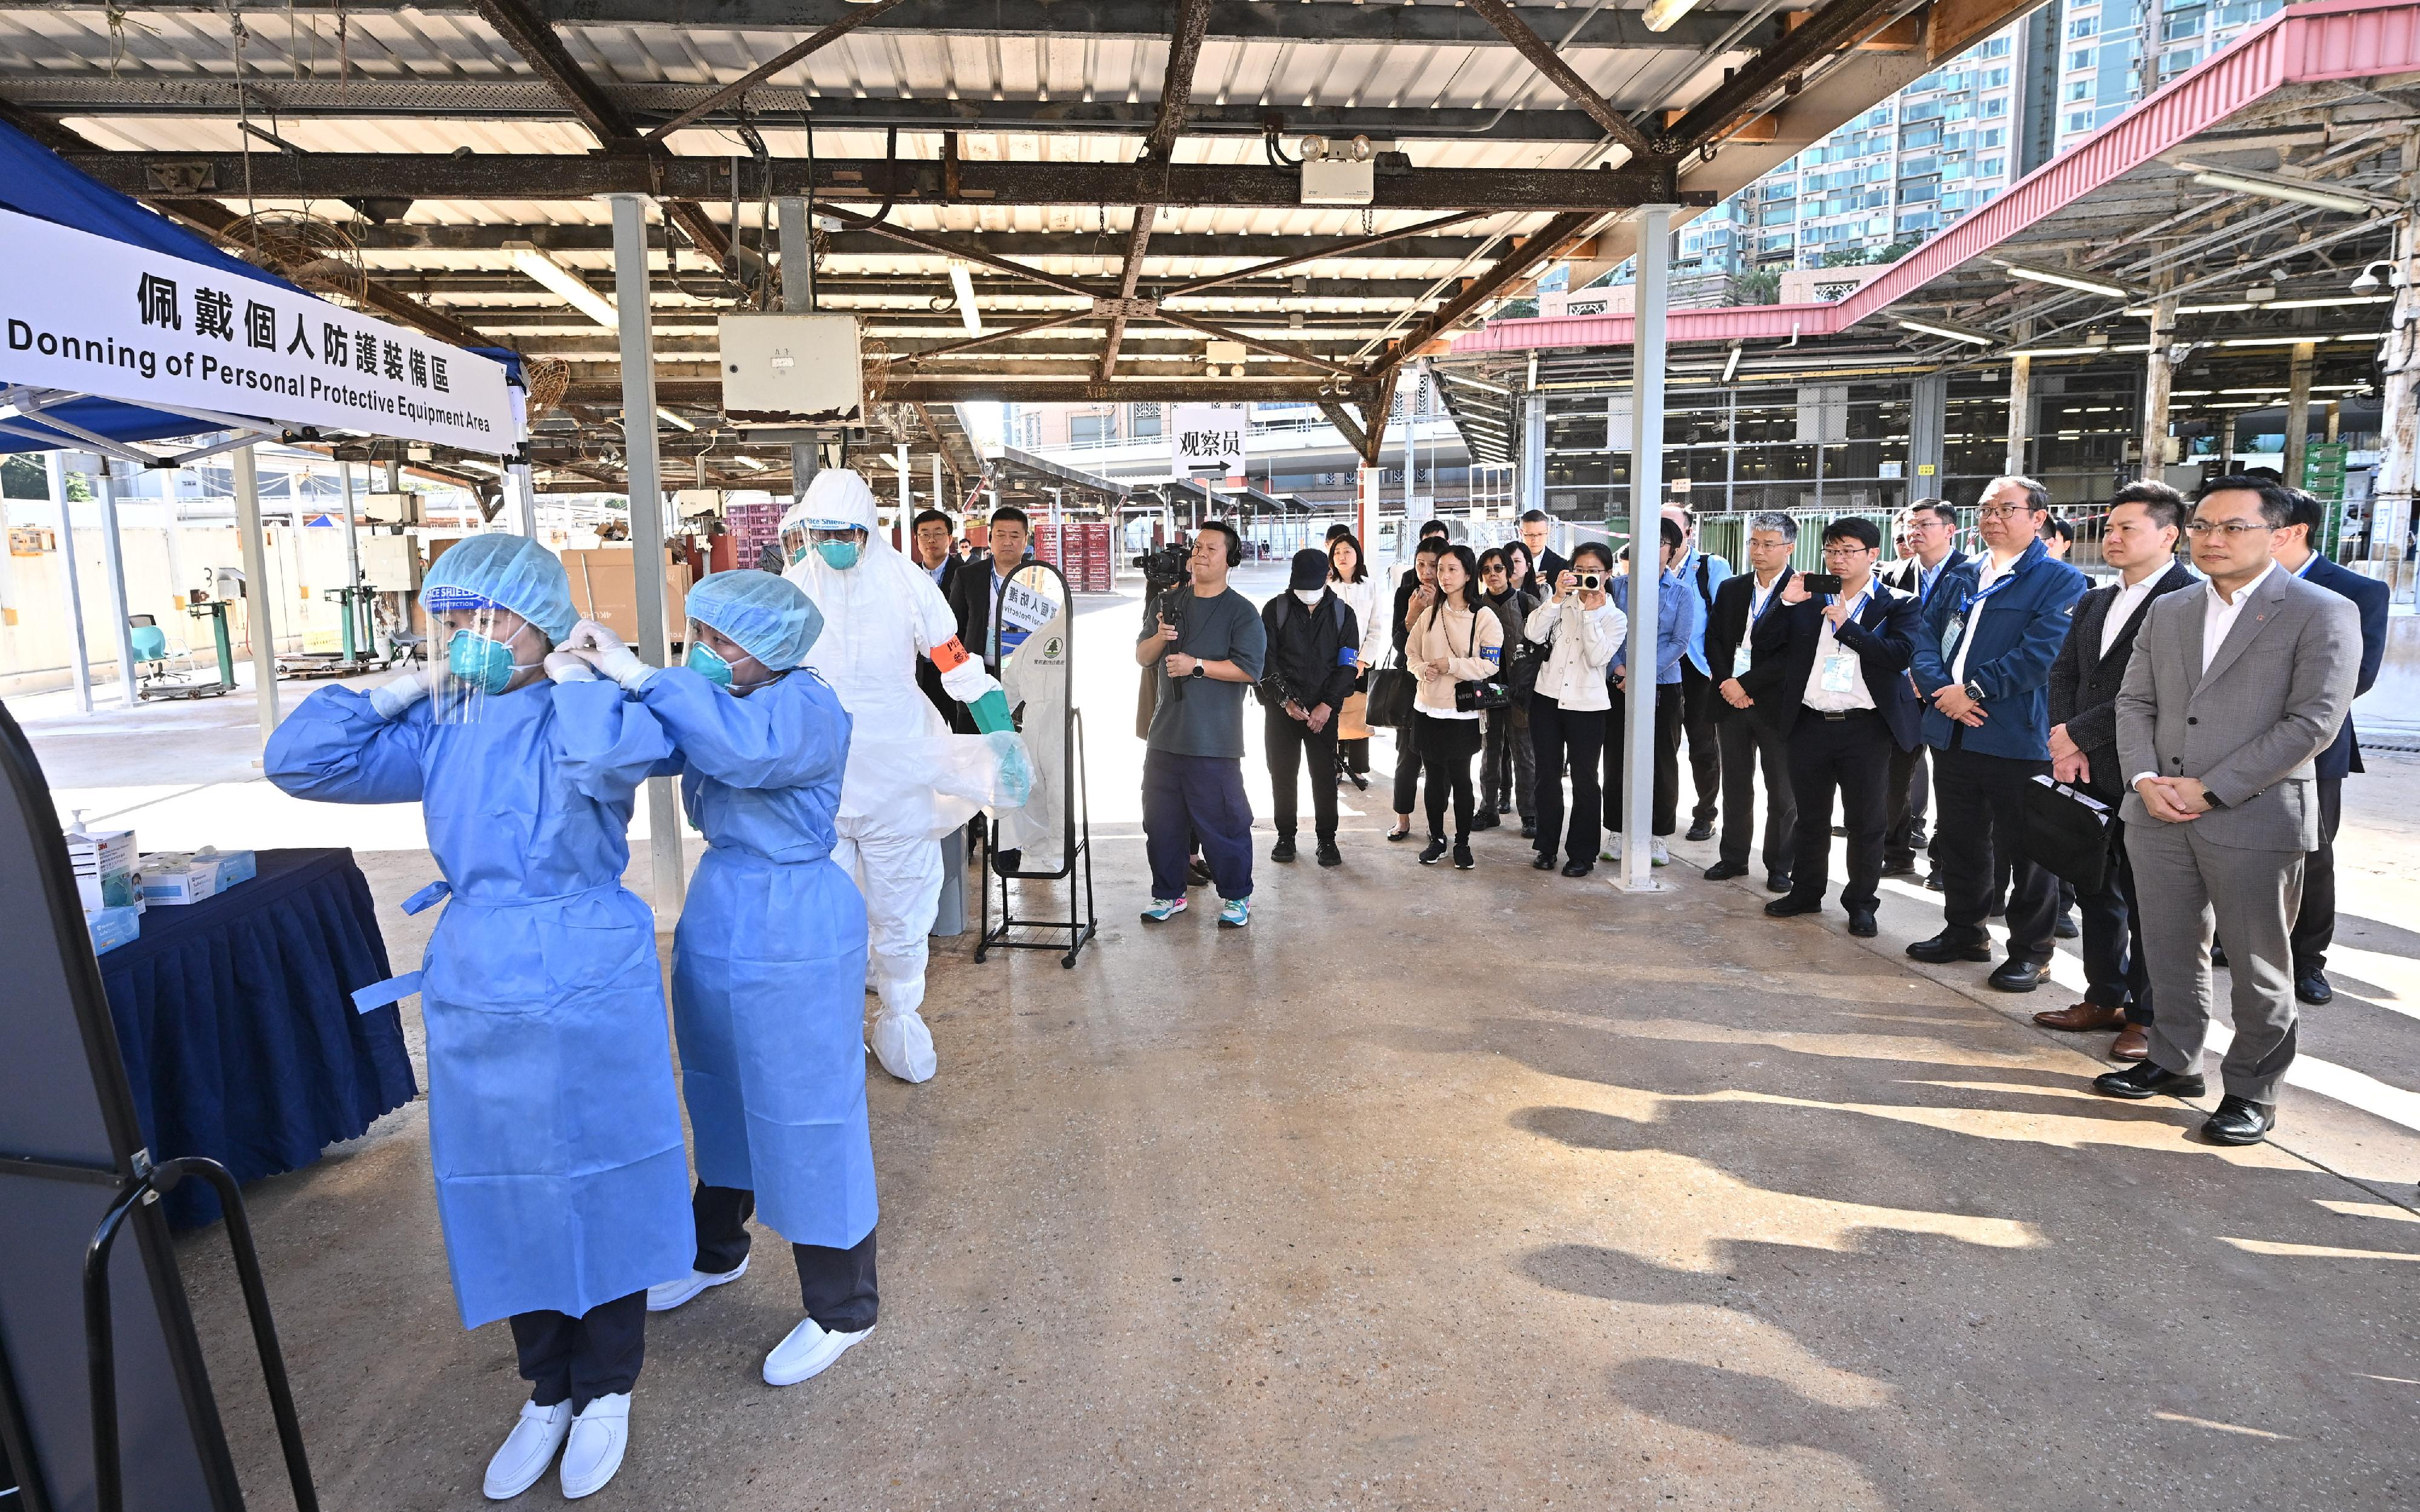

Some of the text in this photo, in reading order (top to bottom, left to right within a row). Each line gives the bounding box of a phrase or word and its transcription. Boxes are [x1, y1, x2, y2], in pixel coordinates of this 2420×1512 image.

[137, 272, 450, 393] 佩戴個人防護裝備區
[8, 319, 490, 432] Donning of Personal Protective Equipment Area
[1179, 430, 1240, 457] 观察员
[427, 588, 440, 598] ACE
[947, 640, 960, 652] Pla
[98, 842, 107, 851] 3M
